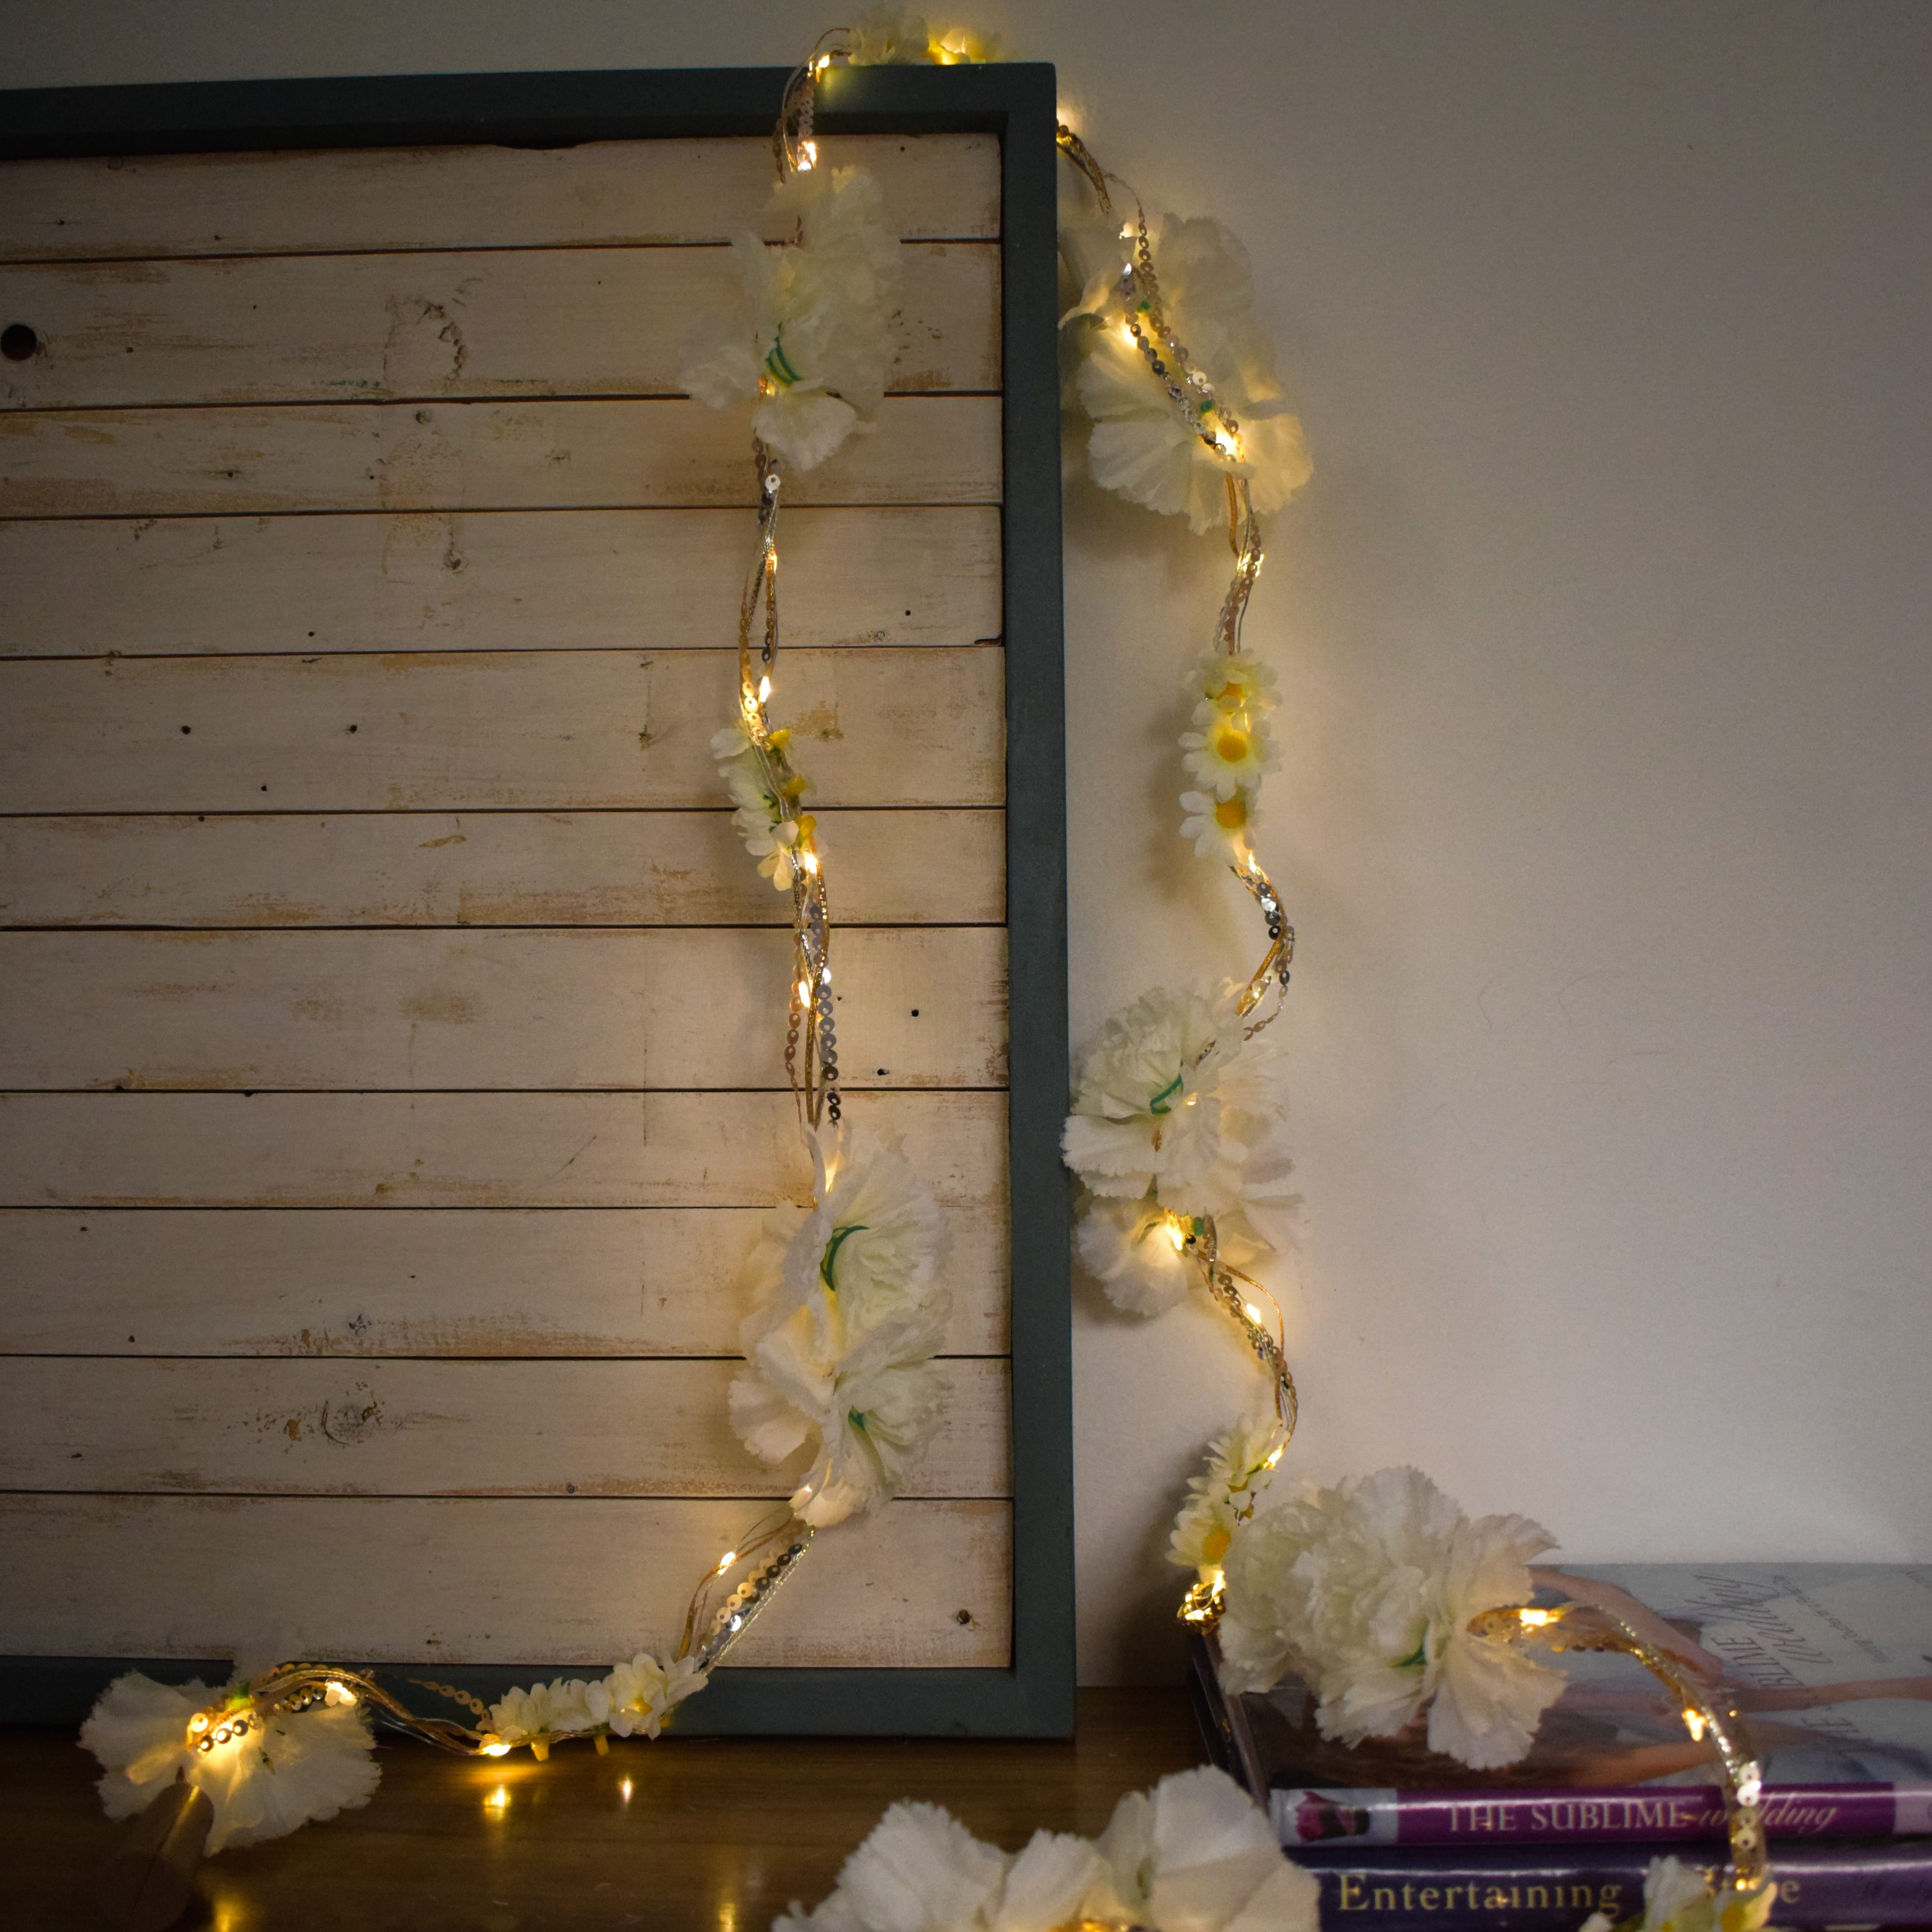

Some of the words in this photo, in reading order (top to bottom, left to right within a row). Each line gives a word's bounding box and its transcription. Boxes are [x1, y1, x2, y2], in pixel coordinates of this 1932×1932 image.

[1447, 1801, 1516, 1832] THE
[1530, 1800, 1688, 1831] SUBLIME
[1698, 1792, 1838, 1834] wding
[1337, 1873, 1621, 1919] Entertaining
